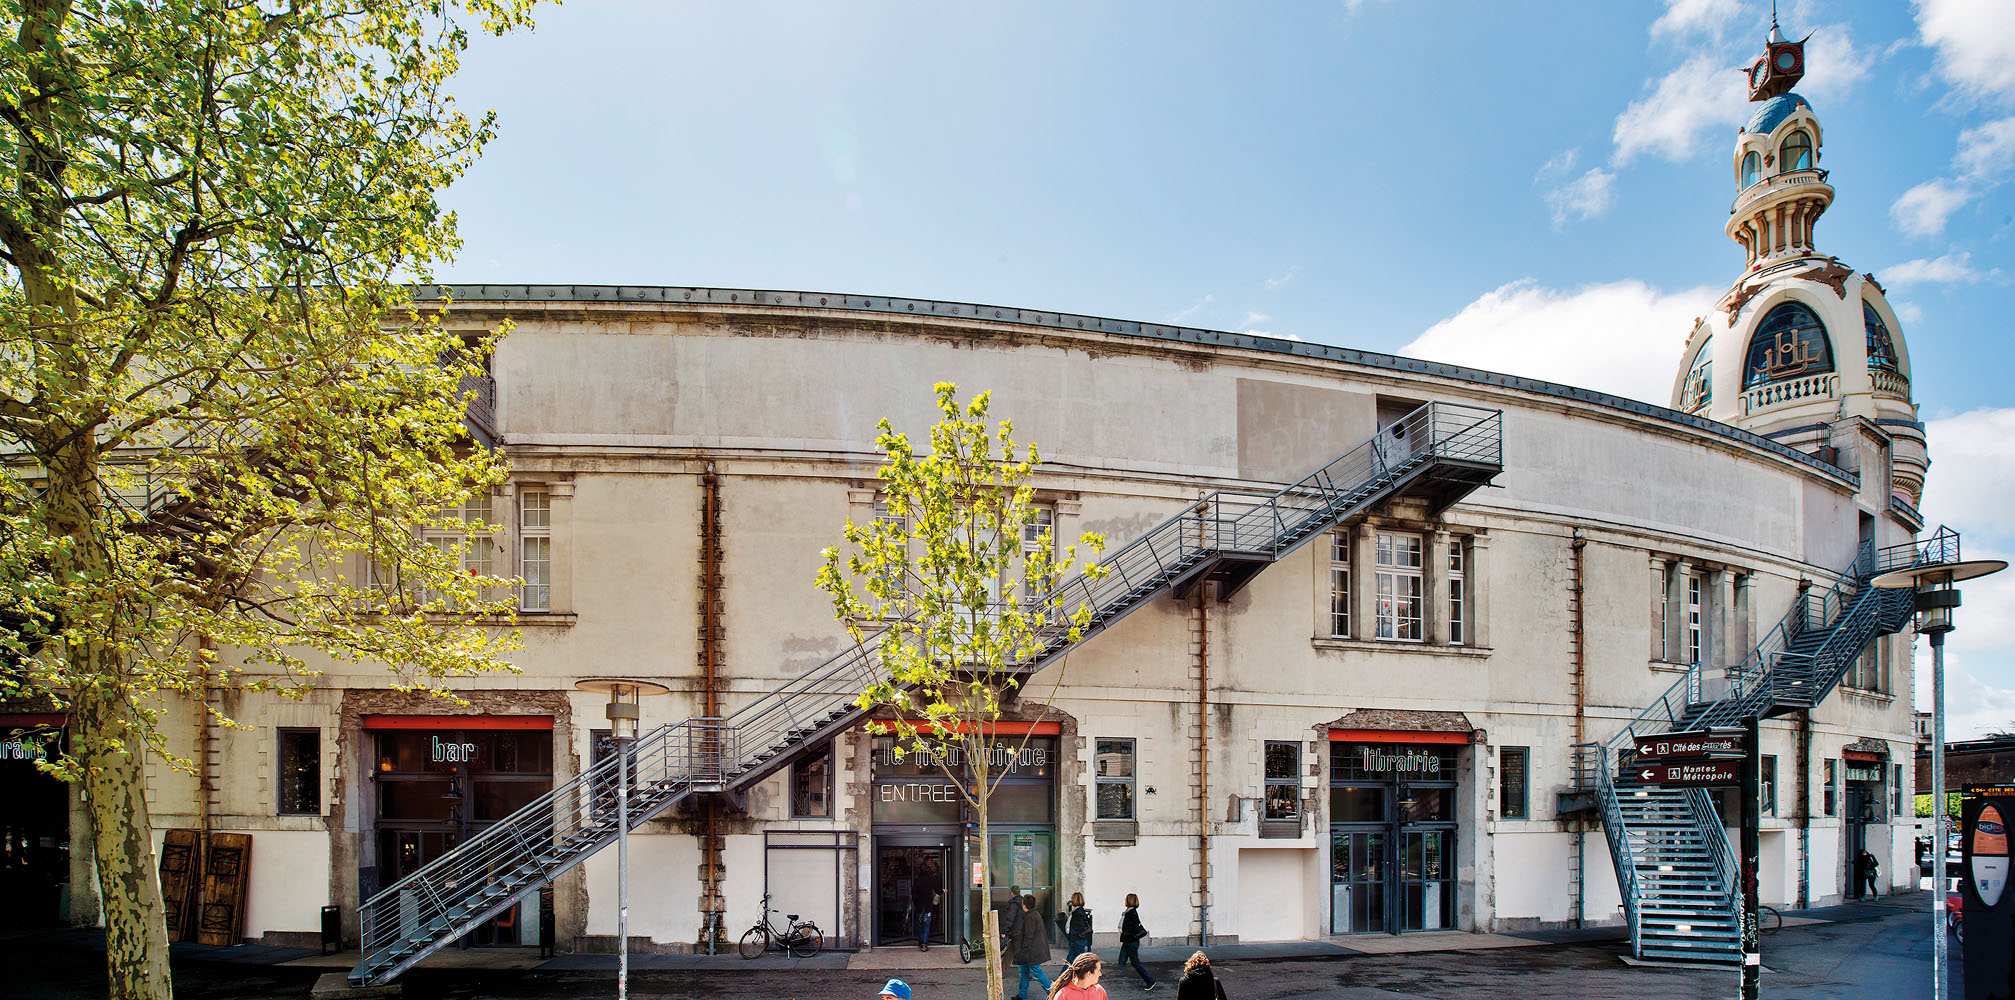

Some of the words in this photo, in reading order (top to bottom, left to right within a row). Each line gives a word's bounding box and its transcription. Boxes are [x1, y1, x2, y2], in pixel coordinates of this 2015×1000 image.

[432, 735, 475, 762] bar
[883, 741, 904, 766] le
[1672, 743, 1687, 752] Cité
[1688, 743, 1701, 751] des
[1363, 747, 1439, 773] librairie
[1683, 765, 1716, 773] Nantes
[1683, 772, 1732, 781] Métropole
[881, 783, 956, 802] ENTREE
